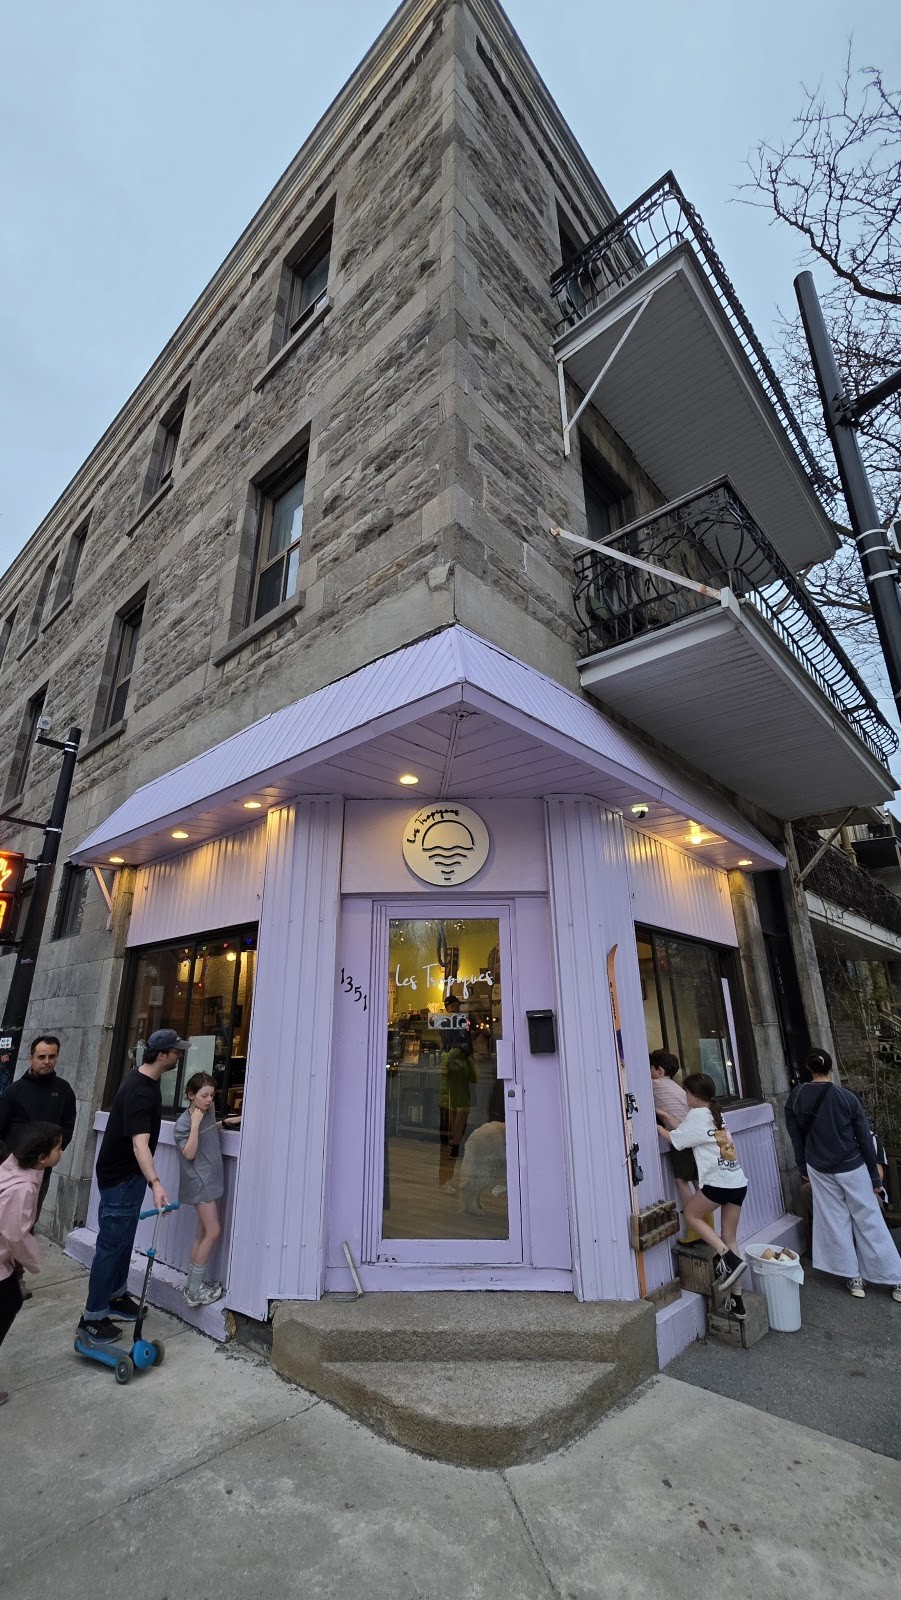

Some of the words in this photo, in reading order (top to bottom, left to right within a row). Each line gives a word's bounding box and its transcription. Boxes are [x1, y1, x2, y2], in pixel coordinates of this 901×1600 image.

[407, 828, 420, 844] Les
[415, 808, 460, 825] Tropiques
[340, 968, 367, 1012] 1351
[395, 964, 418, 991] Les
[422, 963, 494, 999] Tropiques
[428, 1014, 468, 1029] Café
